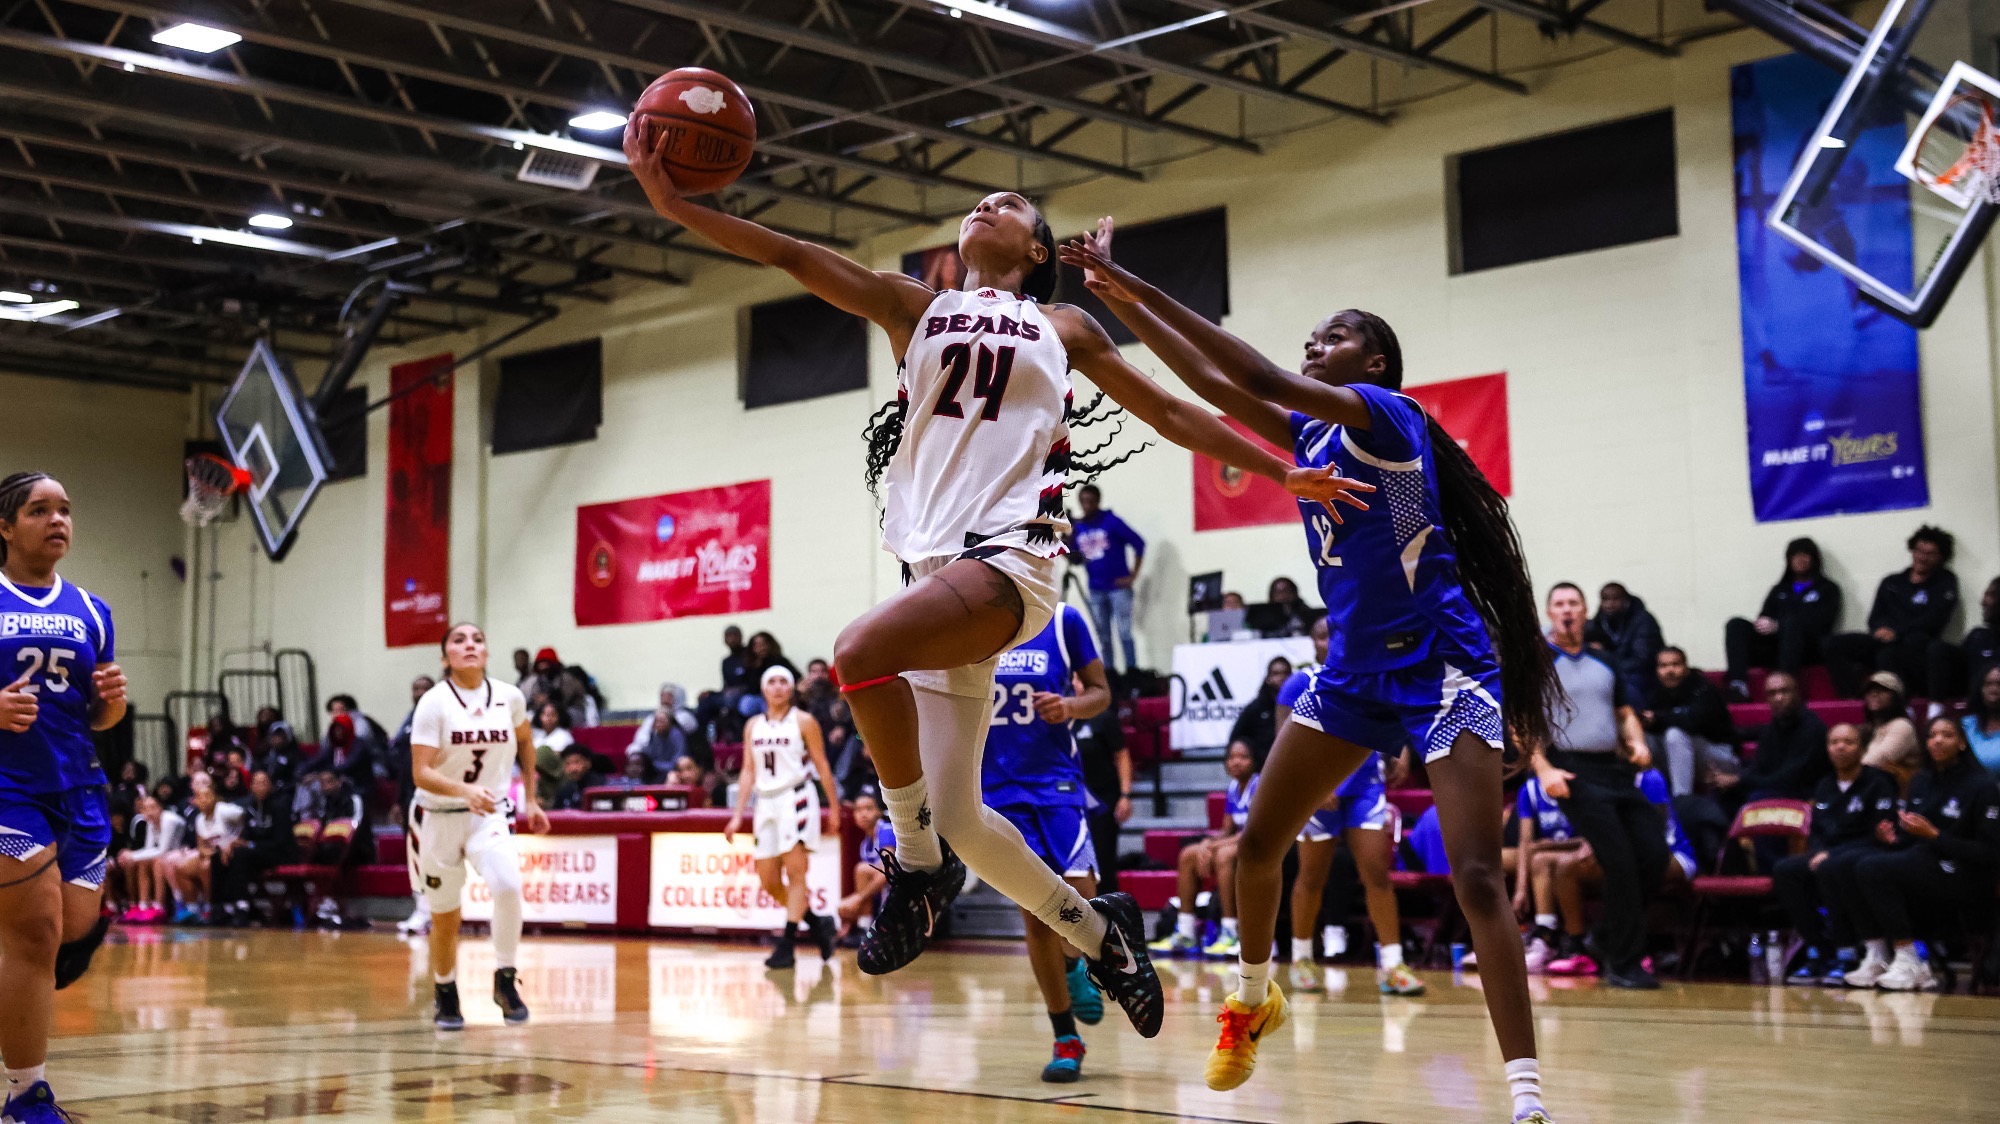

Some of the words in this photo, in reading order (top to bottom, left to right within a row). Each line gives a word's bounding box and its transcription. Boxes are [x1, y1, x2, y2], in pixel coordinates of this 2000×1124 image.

[924, 313, 1041, 341] BEARS
[932, 343, 1016, 421] 24
[1311, 514, 1343, 567] 12
[2, 614, 86, 641] BOBCATS
[16, 647, 76, 693] 25
[998, 652, 1046, 673] BCATS
[991, 683, 1035, 725] 23
[452, 730, 509, 744] BEARS
[464, 750, 487, 783] 3
[764, 751, 775, 776] 4
[549, 882, 610, 904] BEARS
[663, 886, 752, 908] COLLEGE
